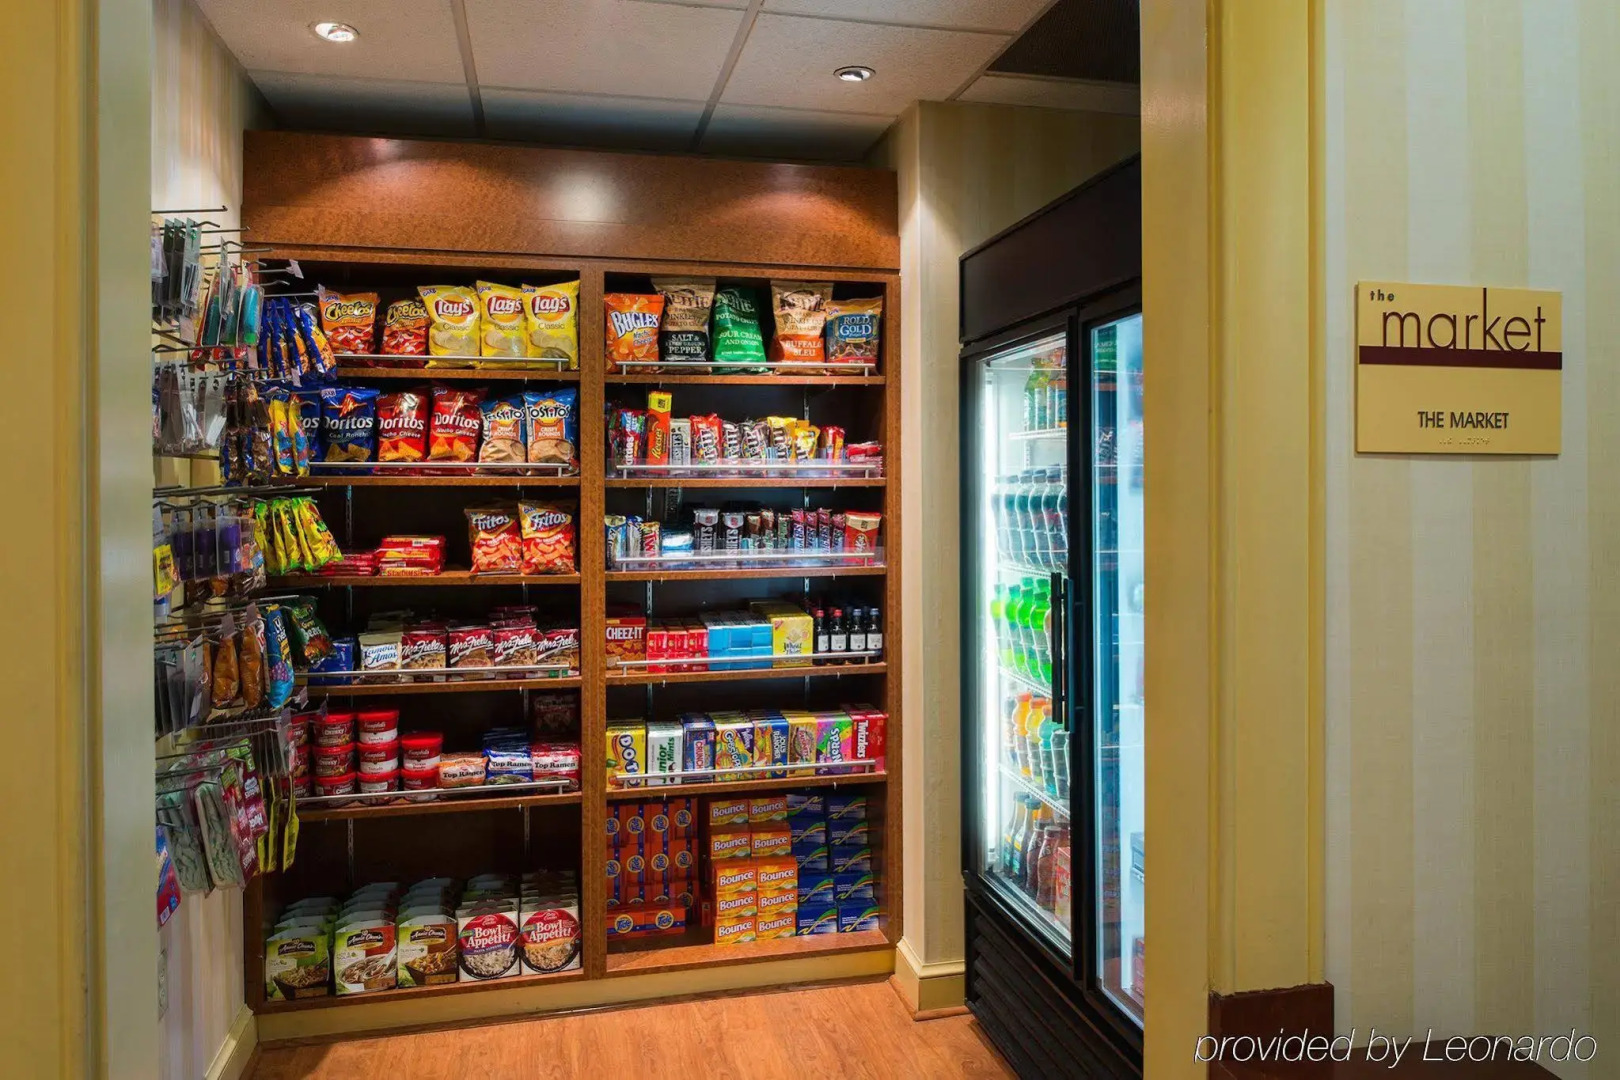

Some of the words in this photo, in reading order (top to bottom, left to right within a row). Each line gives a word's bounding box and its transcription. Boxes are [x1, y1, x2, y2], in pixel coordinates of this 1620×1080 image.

[1370, 289, 1395, 301] the
[325, 302, 373, 321] Cheetos
[610, 311, 659, 338] BUGLES
[843, 316, 870, 325] ROLD
[1382, 288, 1546, 351] market
[671, 334, 693, 342] SALT
[839, 325, 872, 336] GOLD
[669, 346, 703, 354] PEPPER
[434, 412, 480, 430] Doritos
[1418, 411, 1444, 428] THE
[1450, 412, 1509, 429] MARKET
[473, 513, 510, 530] Fritos
[530, 511, 567, 531] Fritos
[606, 627, 643, 640] CHEEZ-IT
[857, 720, 868, 758] Twizzlers
[667, 737, 675, 761] Mints
[696, 741, 704, 769] CRUNCH
[550, 761, 576, 769] Ramen
[713, 803, 746, 817] Bounce
[752, 801, 784, 815] Bounce
[714, 836, 748, 851] Bounce
[754, 836, 788, 849] Bounce
[720, 871, 754, 887] Bounce
[760, 869, 794, 882] Bounce
[720, 896, 754, 911] Bounce
[761, 893, 795, 907] Bounce
[474, 925, 501, 938] Bowl
[536, 920, 562, 933] Bowl
[718, 921, 753, 937] Bounce
[759, 917, 792, 932] Bounce
